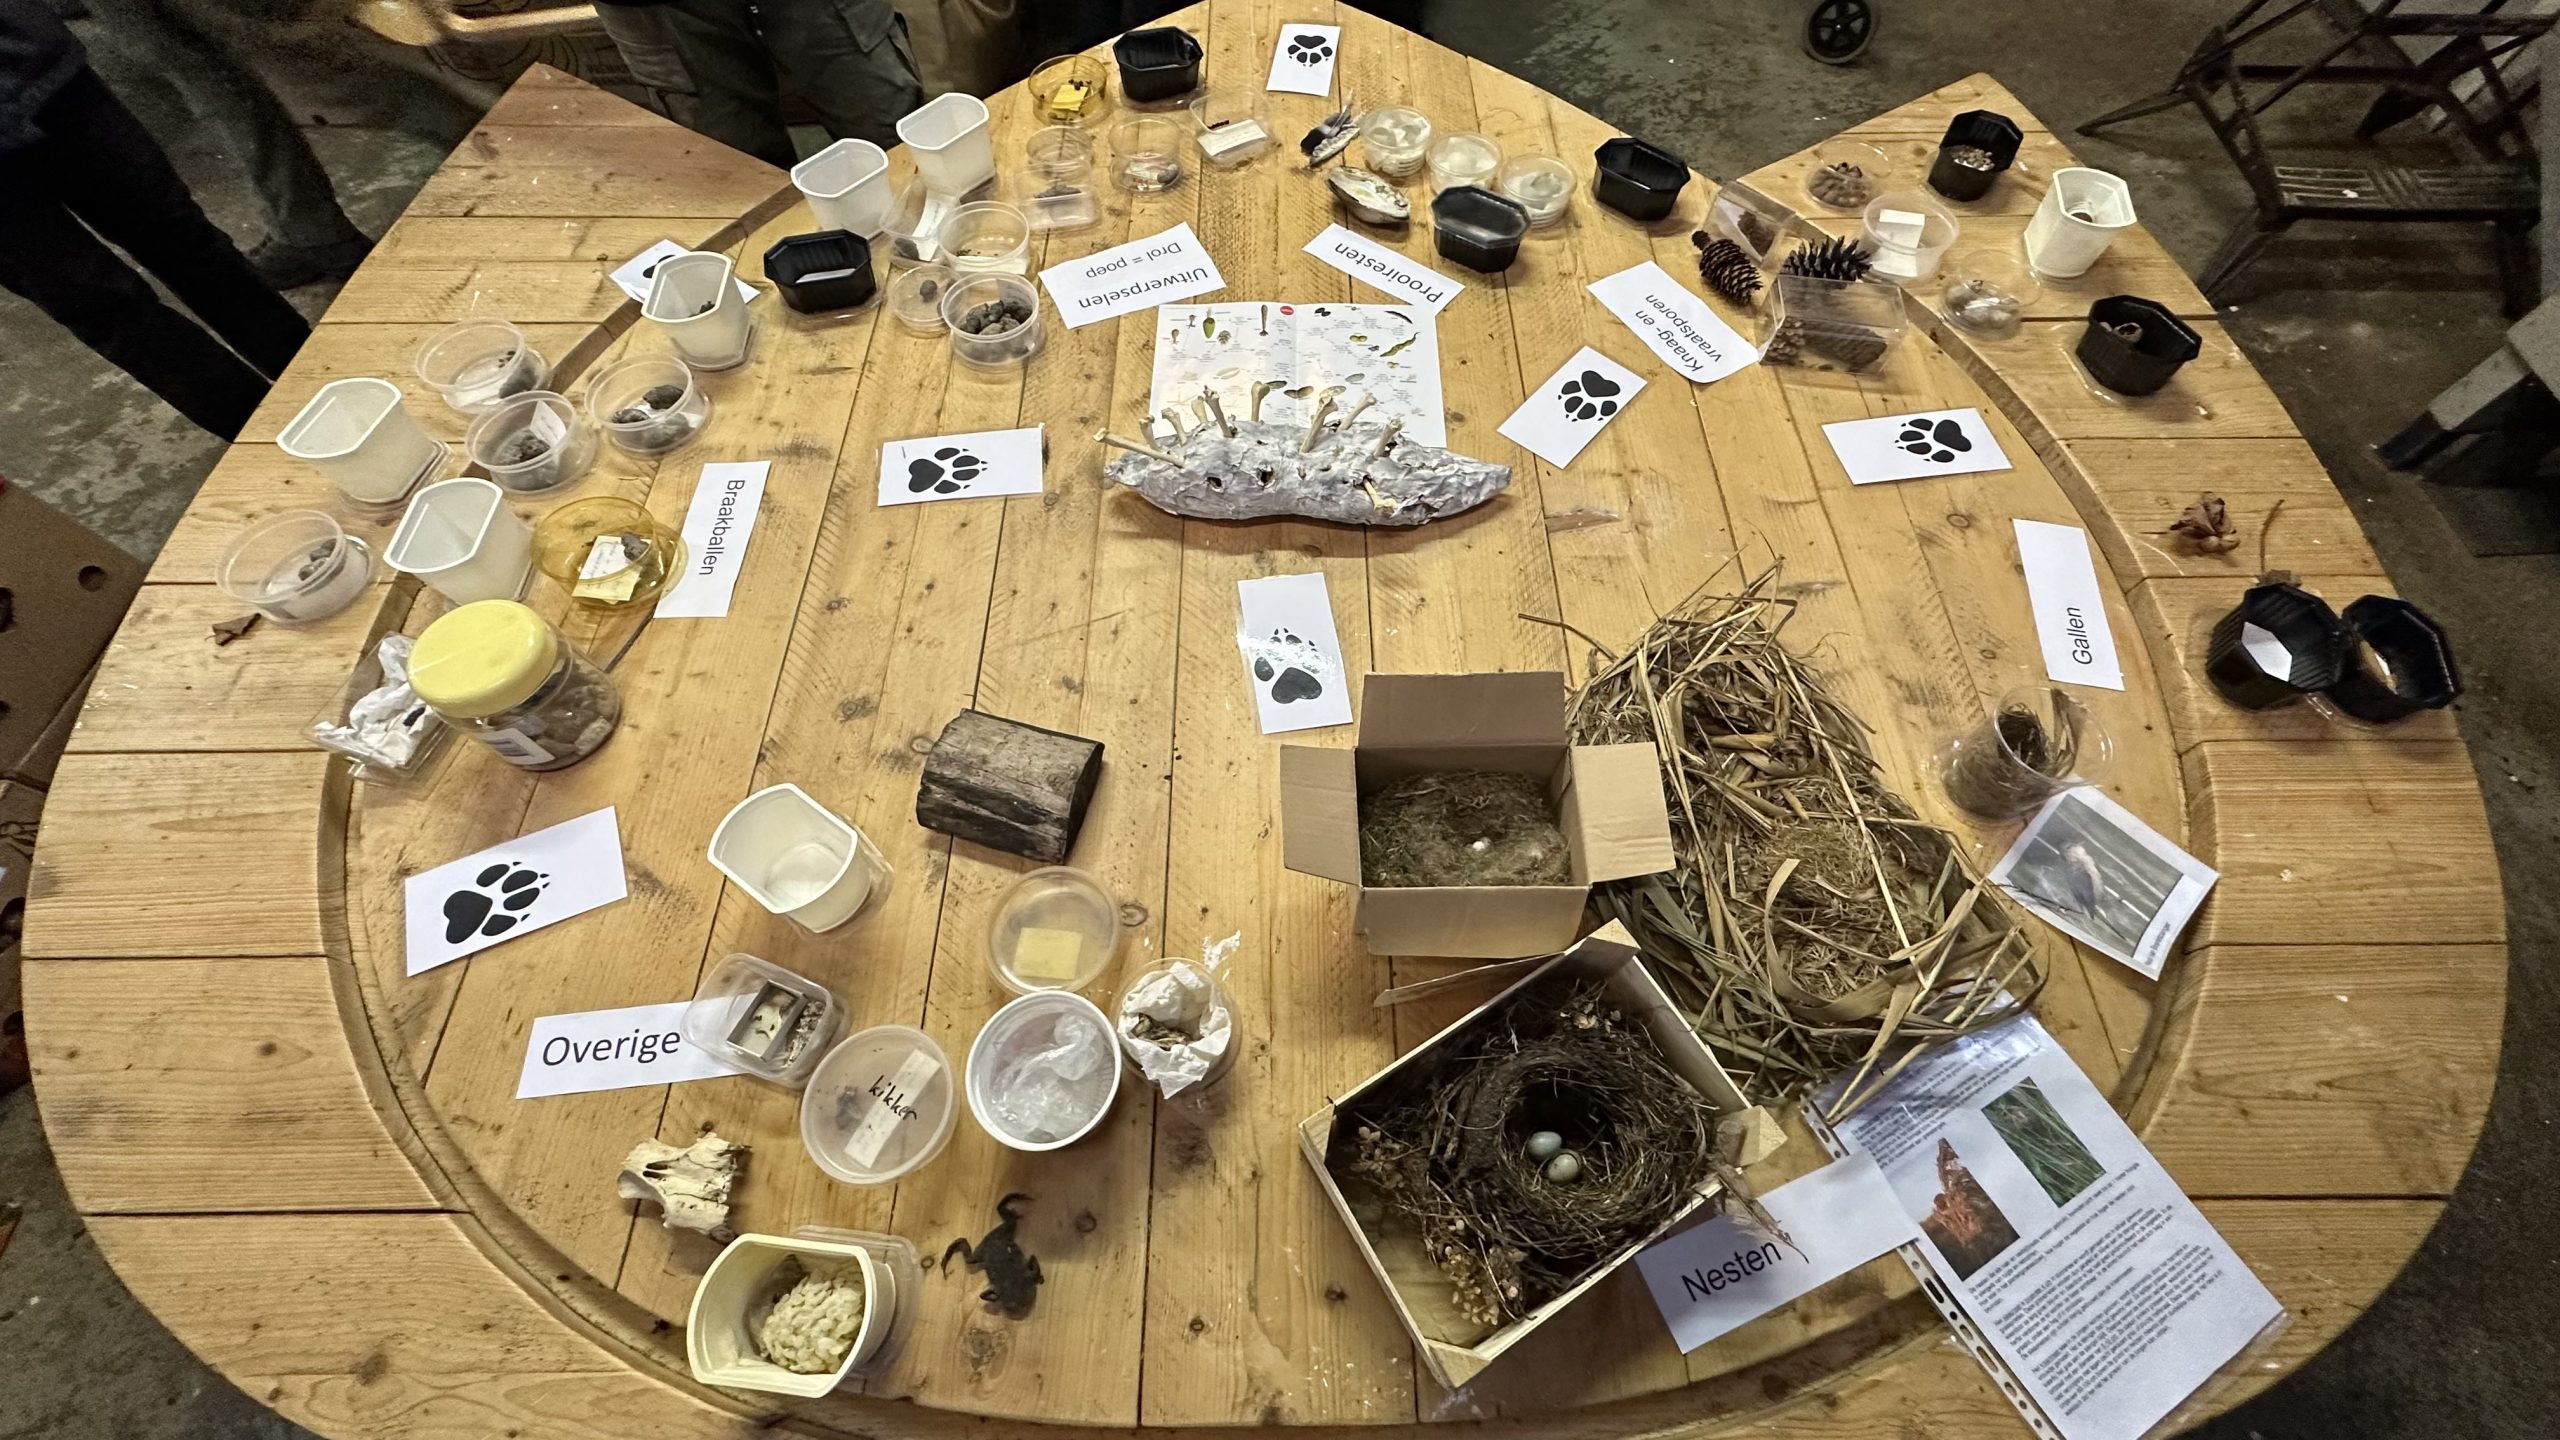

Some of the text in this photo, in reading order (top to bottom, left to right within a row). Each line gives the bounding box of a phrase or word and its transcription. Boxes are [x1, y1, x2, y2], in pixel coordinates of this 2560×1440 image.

[1078, 267, 1209, 308] Uitwerpselen
[1085, 242, 1182, 278] Drol = poep
[1334, 243, 1444, 303] Prooiresten
[1635, 310, 1704, 372] Knaag- en
[1645, 294, 1722, 363] vraatsporen
[698, 479, 746, 576] Braakballen
[2066, 607, 2093, 665] Gallen
[542, 1028, 681, 1067] Overige
[868, 1074, 917, 1120] kikker
[1681, 1242, 1782, 1302] Nesten
